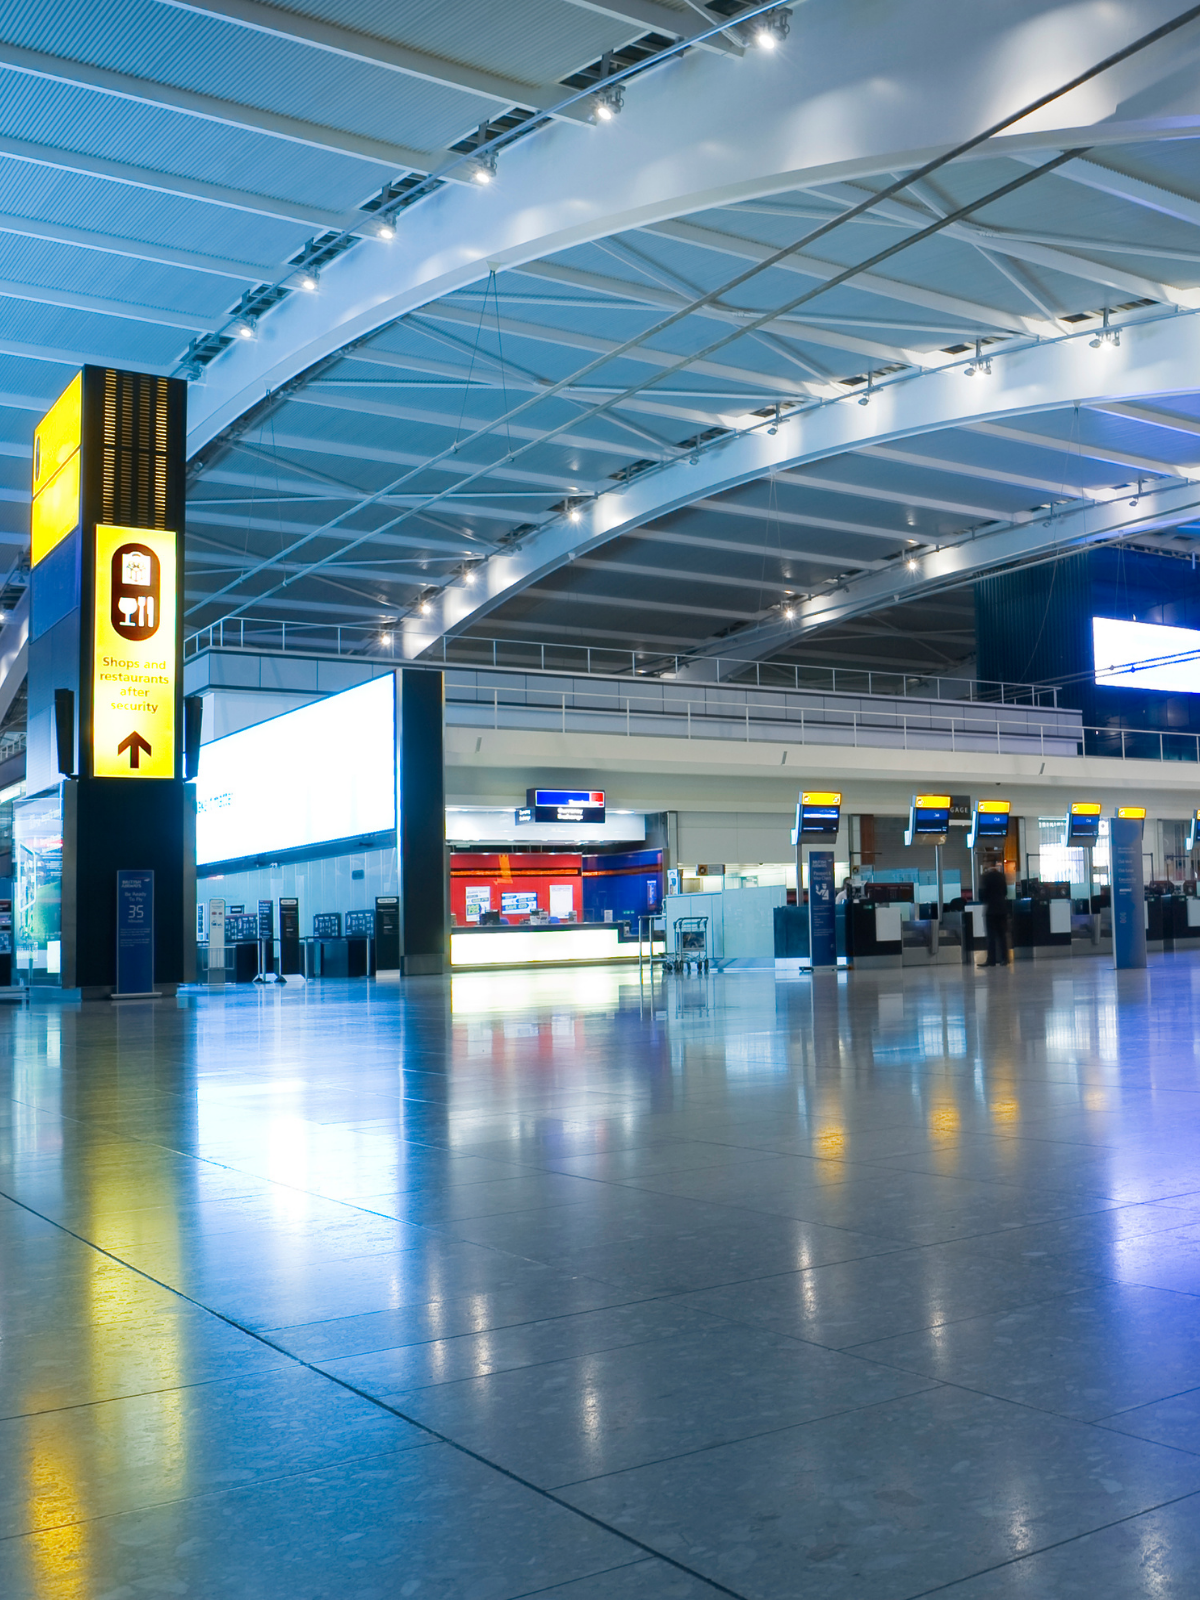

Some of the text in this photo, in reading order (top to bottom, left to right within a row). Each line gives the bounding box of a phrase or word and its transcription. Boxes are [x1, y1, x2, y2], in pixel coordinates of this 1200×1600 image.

[103, 656, 166, 670] Shops and
[100, 673, 169, 684] restaurants
[120, 686, 150, 697] after
[111, 701, 158, 714] security
[949, 806, 969, 814] GAGE
[128, 904, 144, 919] 35
